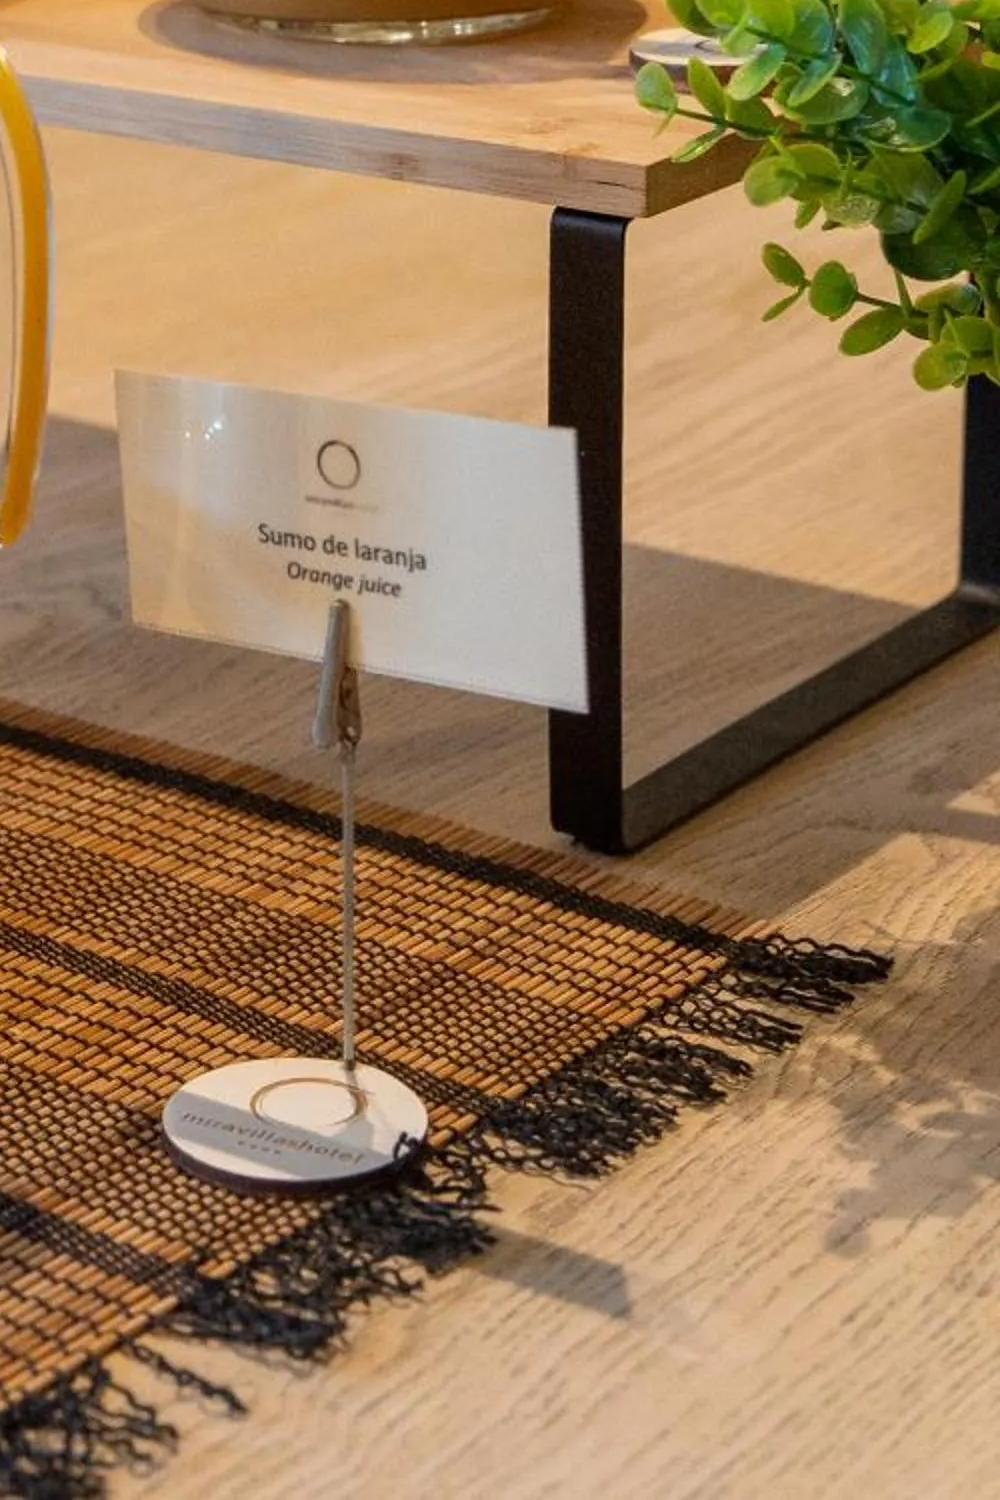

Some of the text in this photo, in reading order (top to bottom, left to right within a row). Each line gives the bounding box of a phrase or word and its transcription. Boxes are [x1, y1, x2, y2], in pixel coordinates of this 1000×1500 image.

[257, 522, 427, 573] Sumo de laranja
[287, 561, 402, 598] Orange juice
